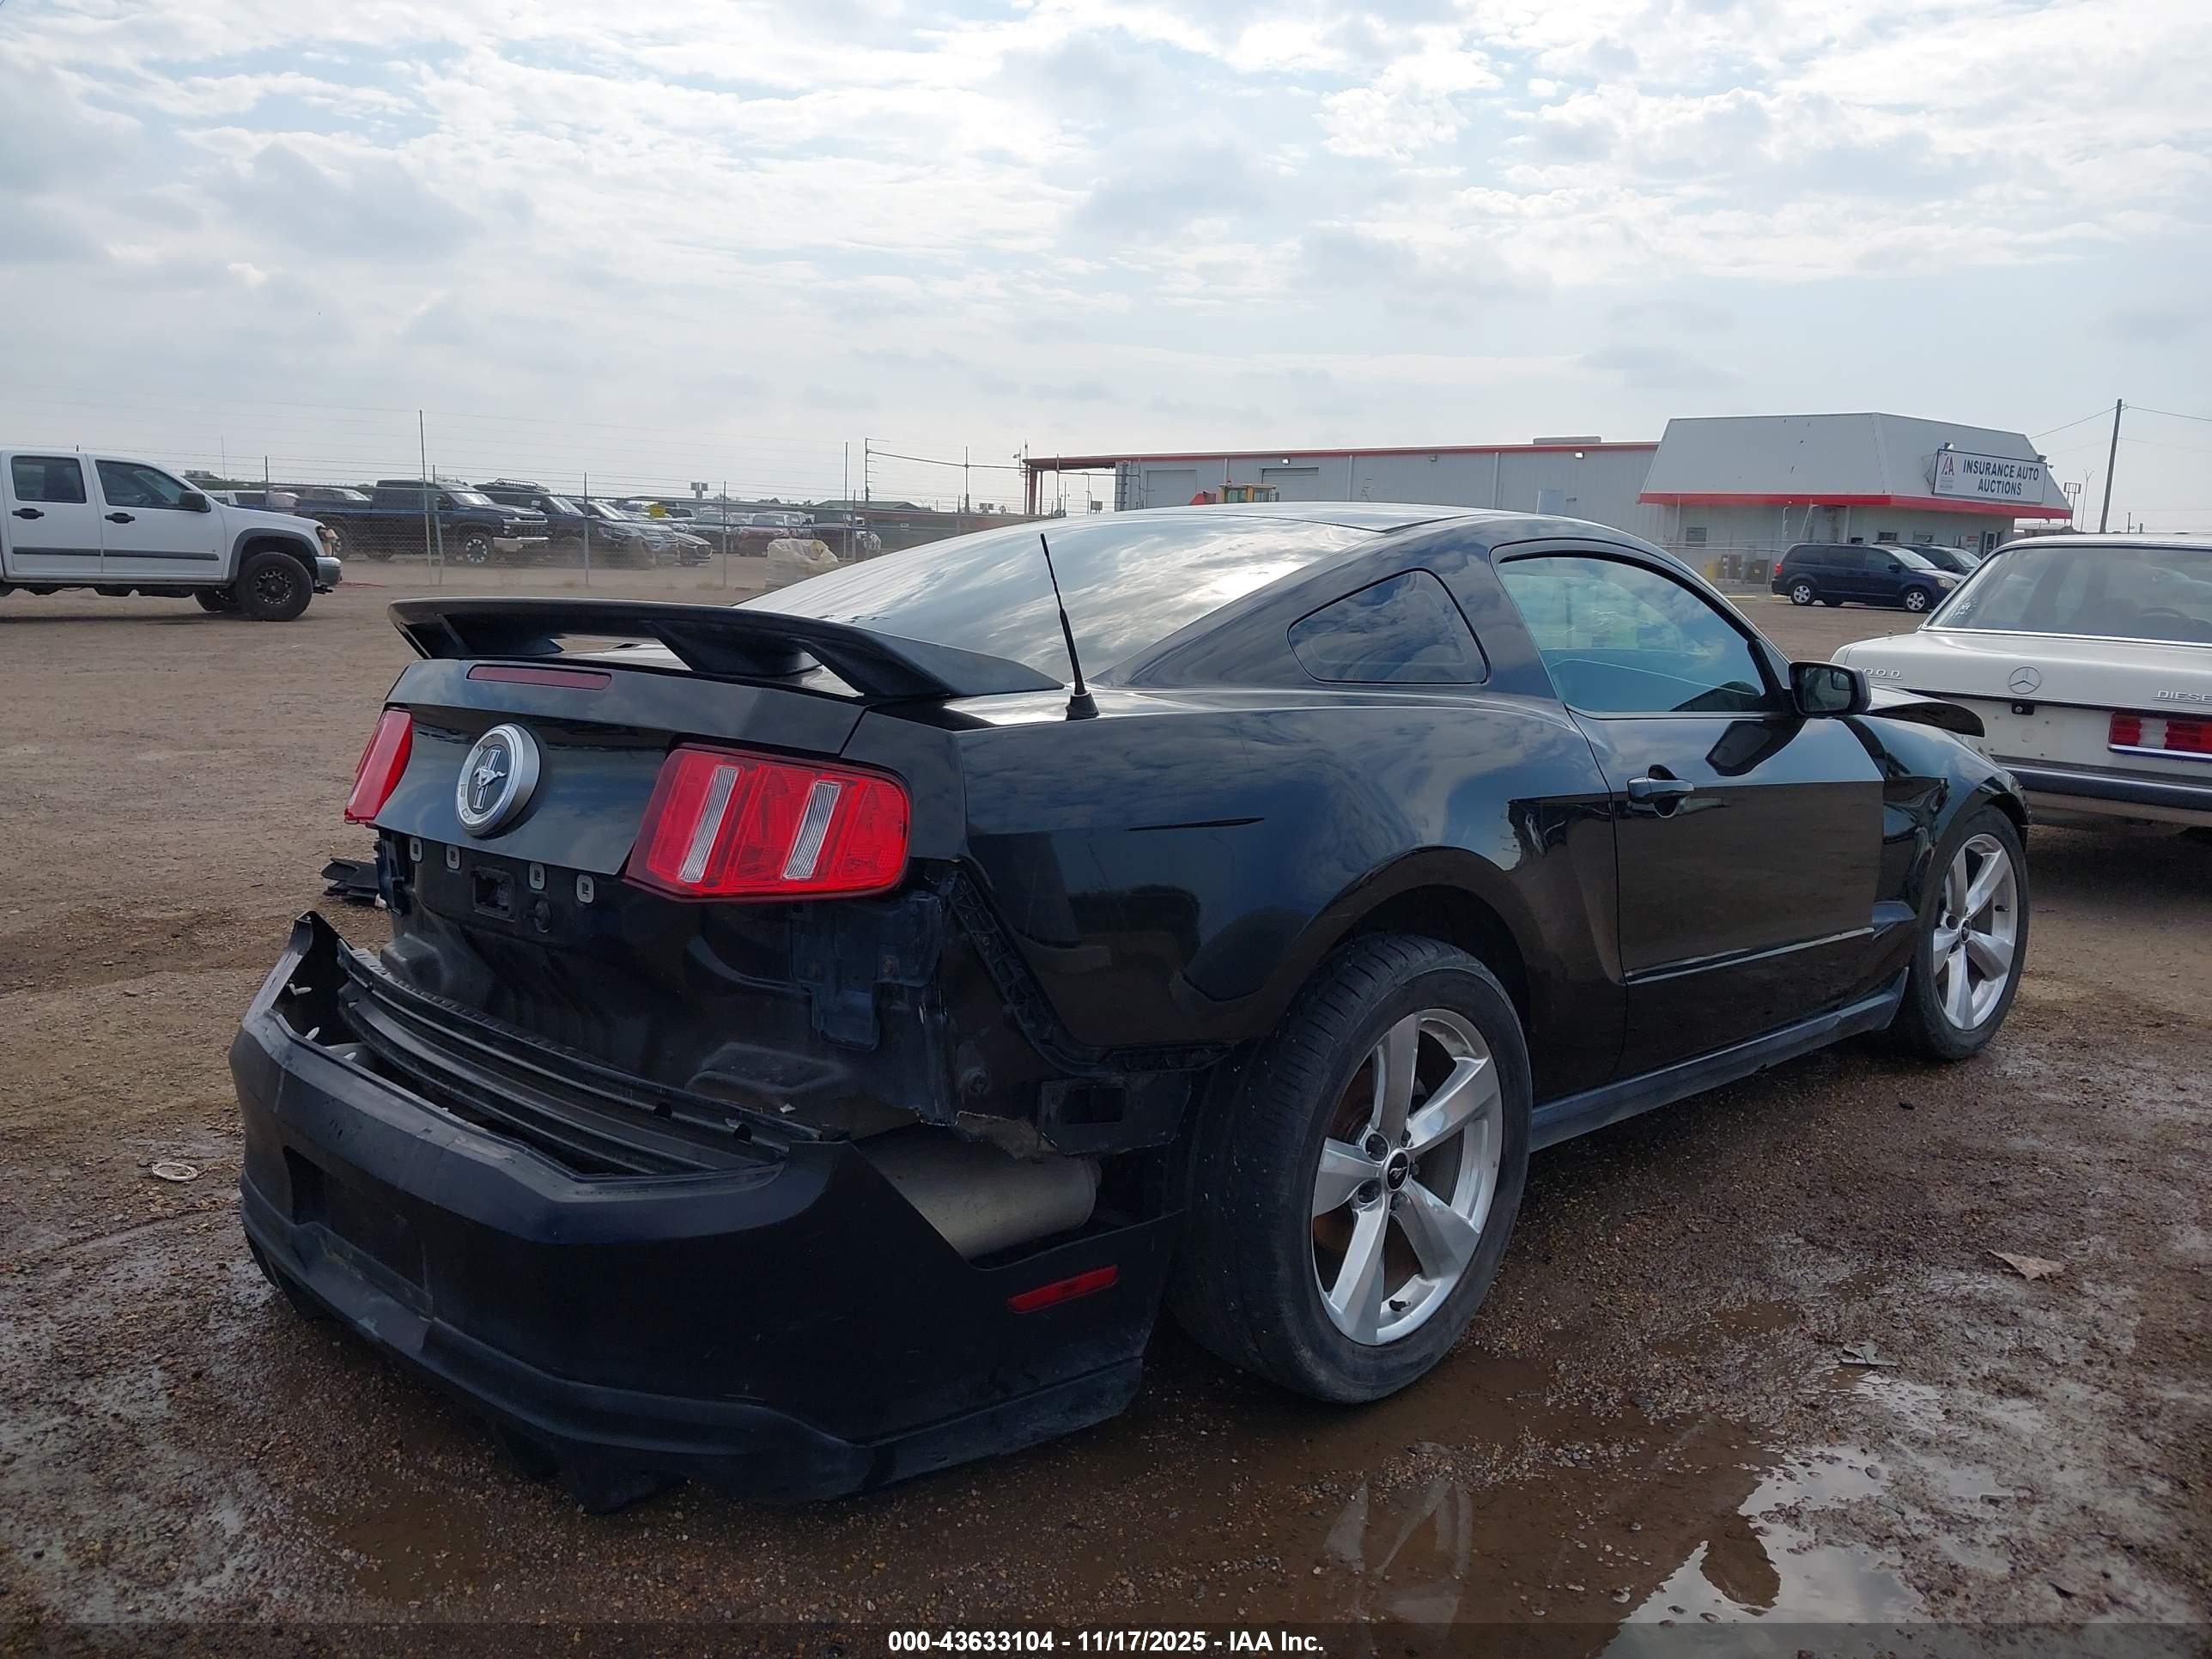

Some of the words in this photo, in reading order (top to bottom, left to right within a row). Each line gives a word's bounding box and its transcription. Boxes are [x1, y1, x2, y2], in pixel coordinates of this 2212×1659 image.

[1963, 459, 2014, 478] INSURANCE
[2017, 466, 2039, 481] AUTO
[1978, 478, 2022, 495] AUCTIONS
